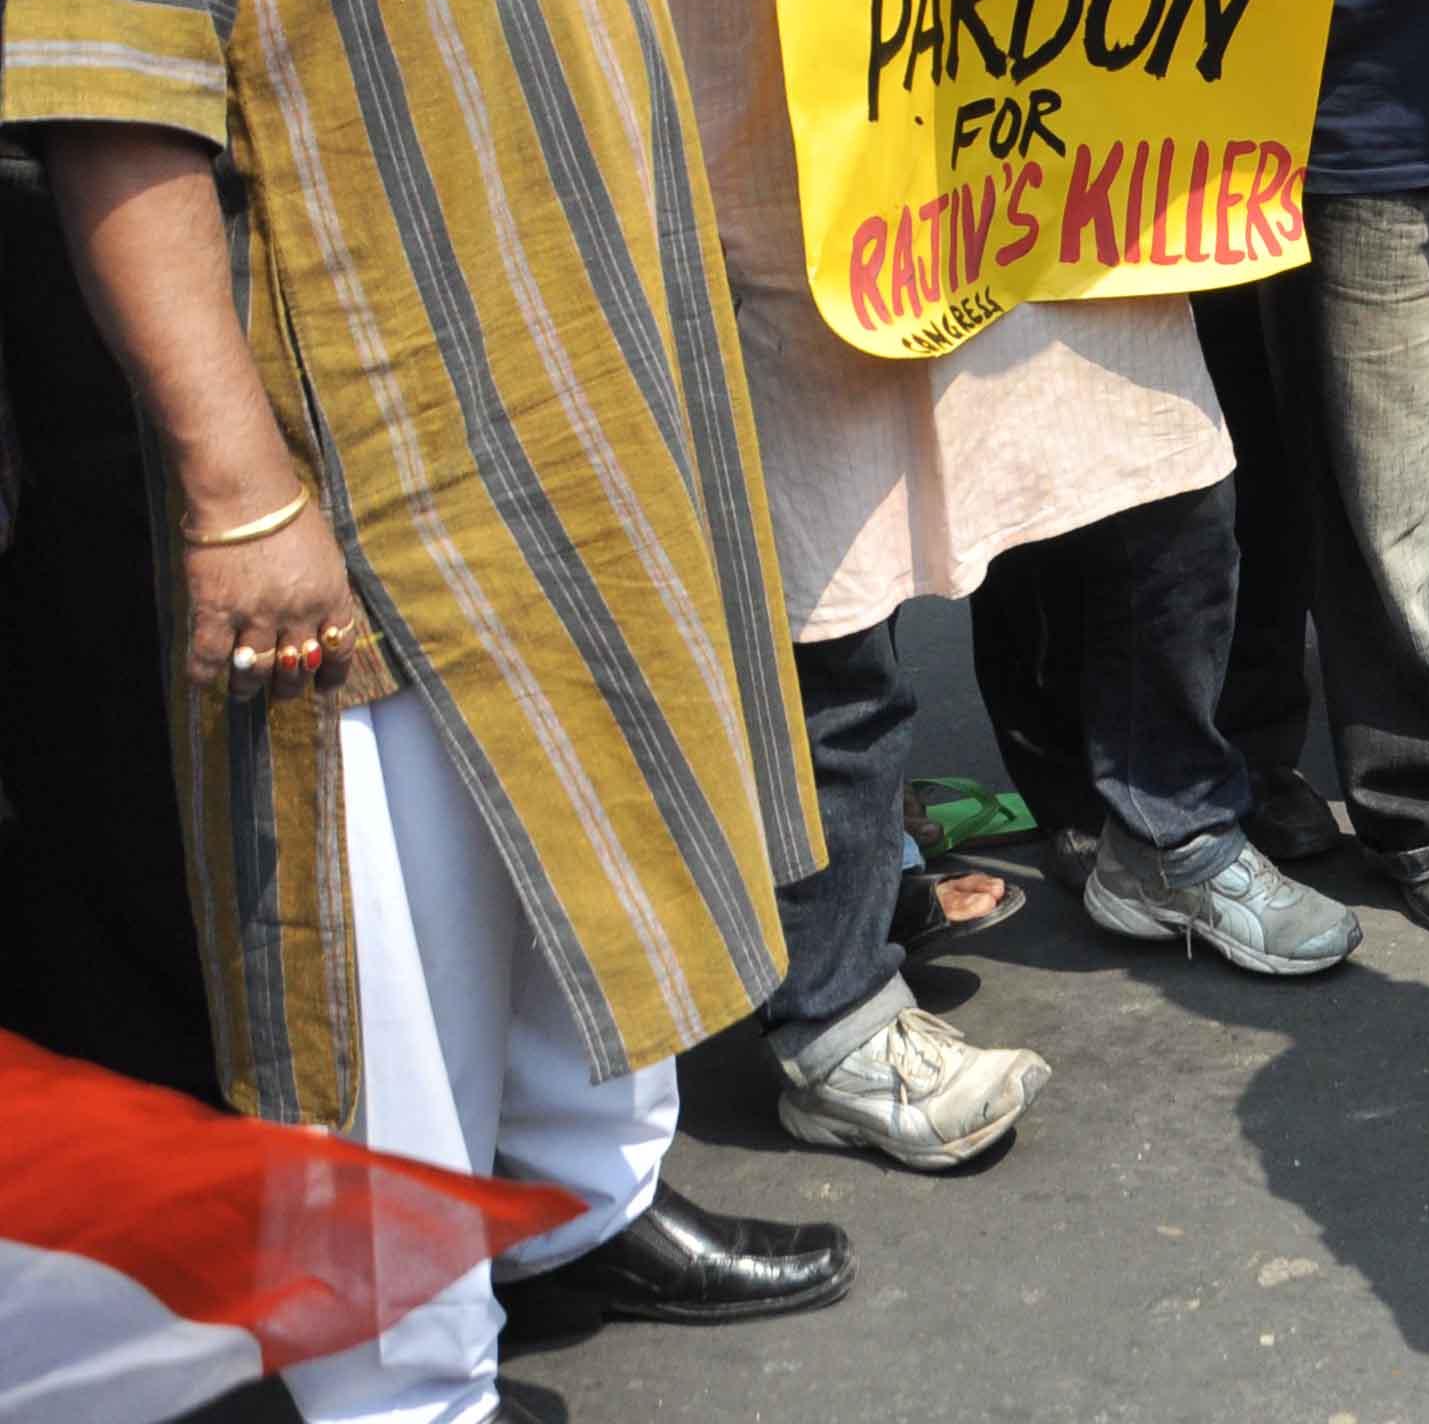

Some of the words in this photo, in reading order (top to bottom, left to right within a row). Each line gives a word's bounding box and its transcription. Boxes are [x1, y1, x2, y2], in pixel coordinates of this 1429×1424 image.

[951, 88, 1067, 172] FOR
[849, 159, 1041, 332] RAJIV'S
[1058, 136, 1305, 268] KILLERS
[901, 285, 1005, 355] CONGRESS
